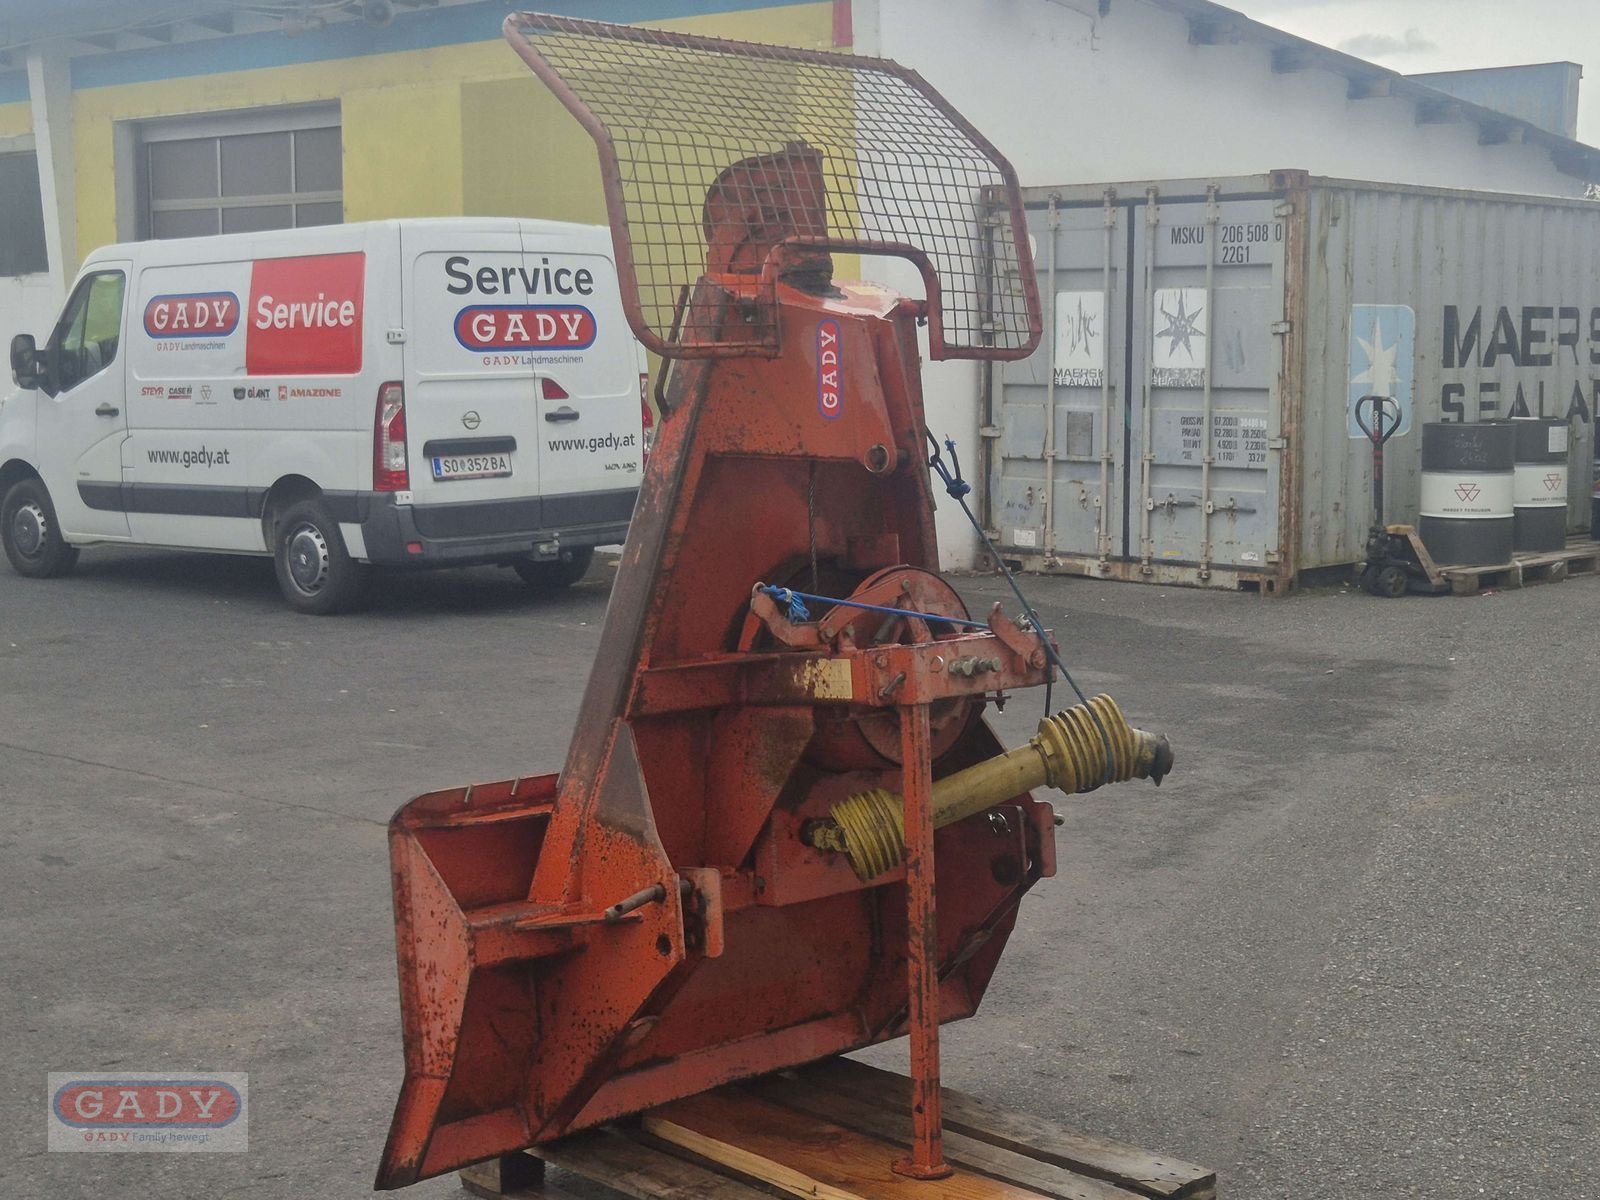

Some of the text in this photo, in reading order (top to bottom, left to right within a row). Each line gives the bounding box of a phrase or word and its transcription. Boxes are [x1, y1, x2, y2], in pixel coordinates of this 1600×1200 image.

[1171, 223, 1282, 245] MSKU 206 508 0
[1222, 246, 1250, 264] 22G1
[445, 256, 593, 295] Service
[153, 300, 231, 330] GADY
[256, 292, 355, 329] Service
[472, 313, 583, 342] GADY
[157, 342, 180, 352] GADY
[482, 355, 584, 366] GADY Landmaschinen
[820, 330, 838, 408] GADY
[141, 386, 164, 396] STEYR
[290, 388, 342, 397] AMAZONE
[548, 432, 636, 453] www.gady.at
[147, 445, 231, 469] www.gady.at
[444, 459, 459, 473] SO
